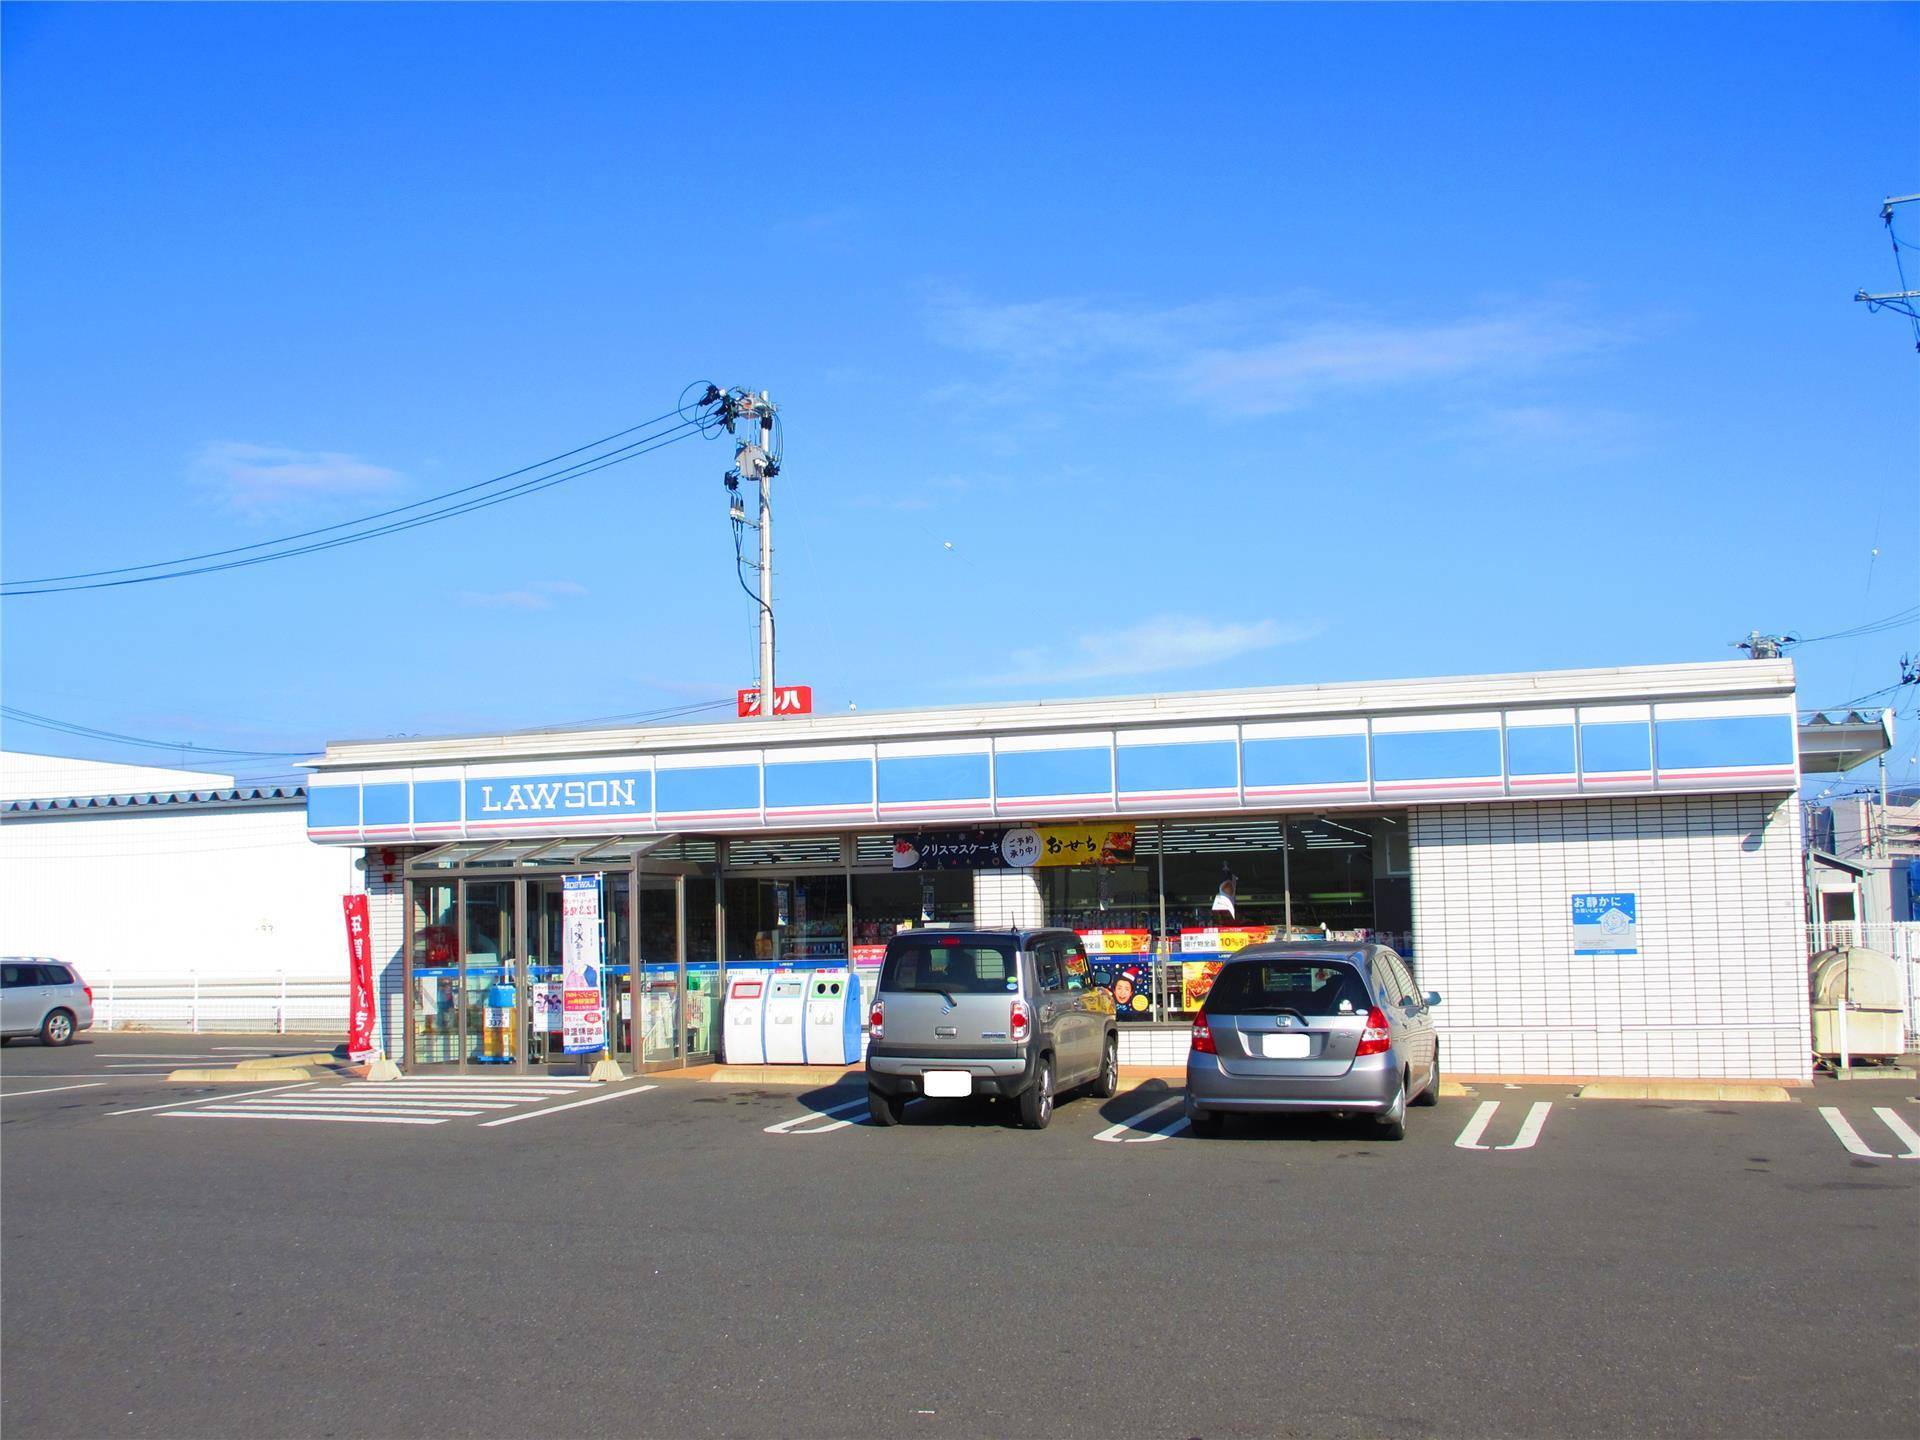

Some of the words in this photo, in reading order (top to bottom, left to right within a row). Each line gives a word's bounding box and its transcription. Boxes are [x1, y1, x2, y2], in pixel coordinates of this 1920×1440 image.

[481, 778, 636, 812] LAWSON
[921, 841, 999, 857] クリスマスケーキ
[1009, 835, 1034, 848] ご予約
[1046, 834, 1097, 855] おせち
[1573, 896, 1622, 908] お静かに
